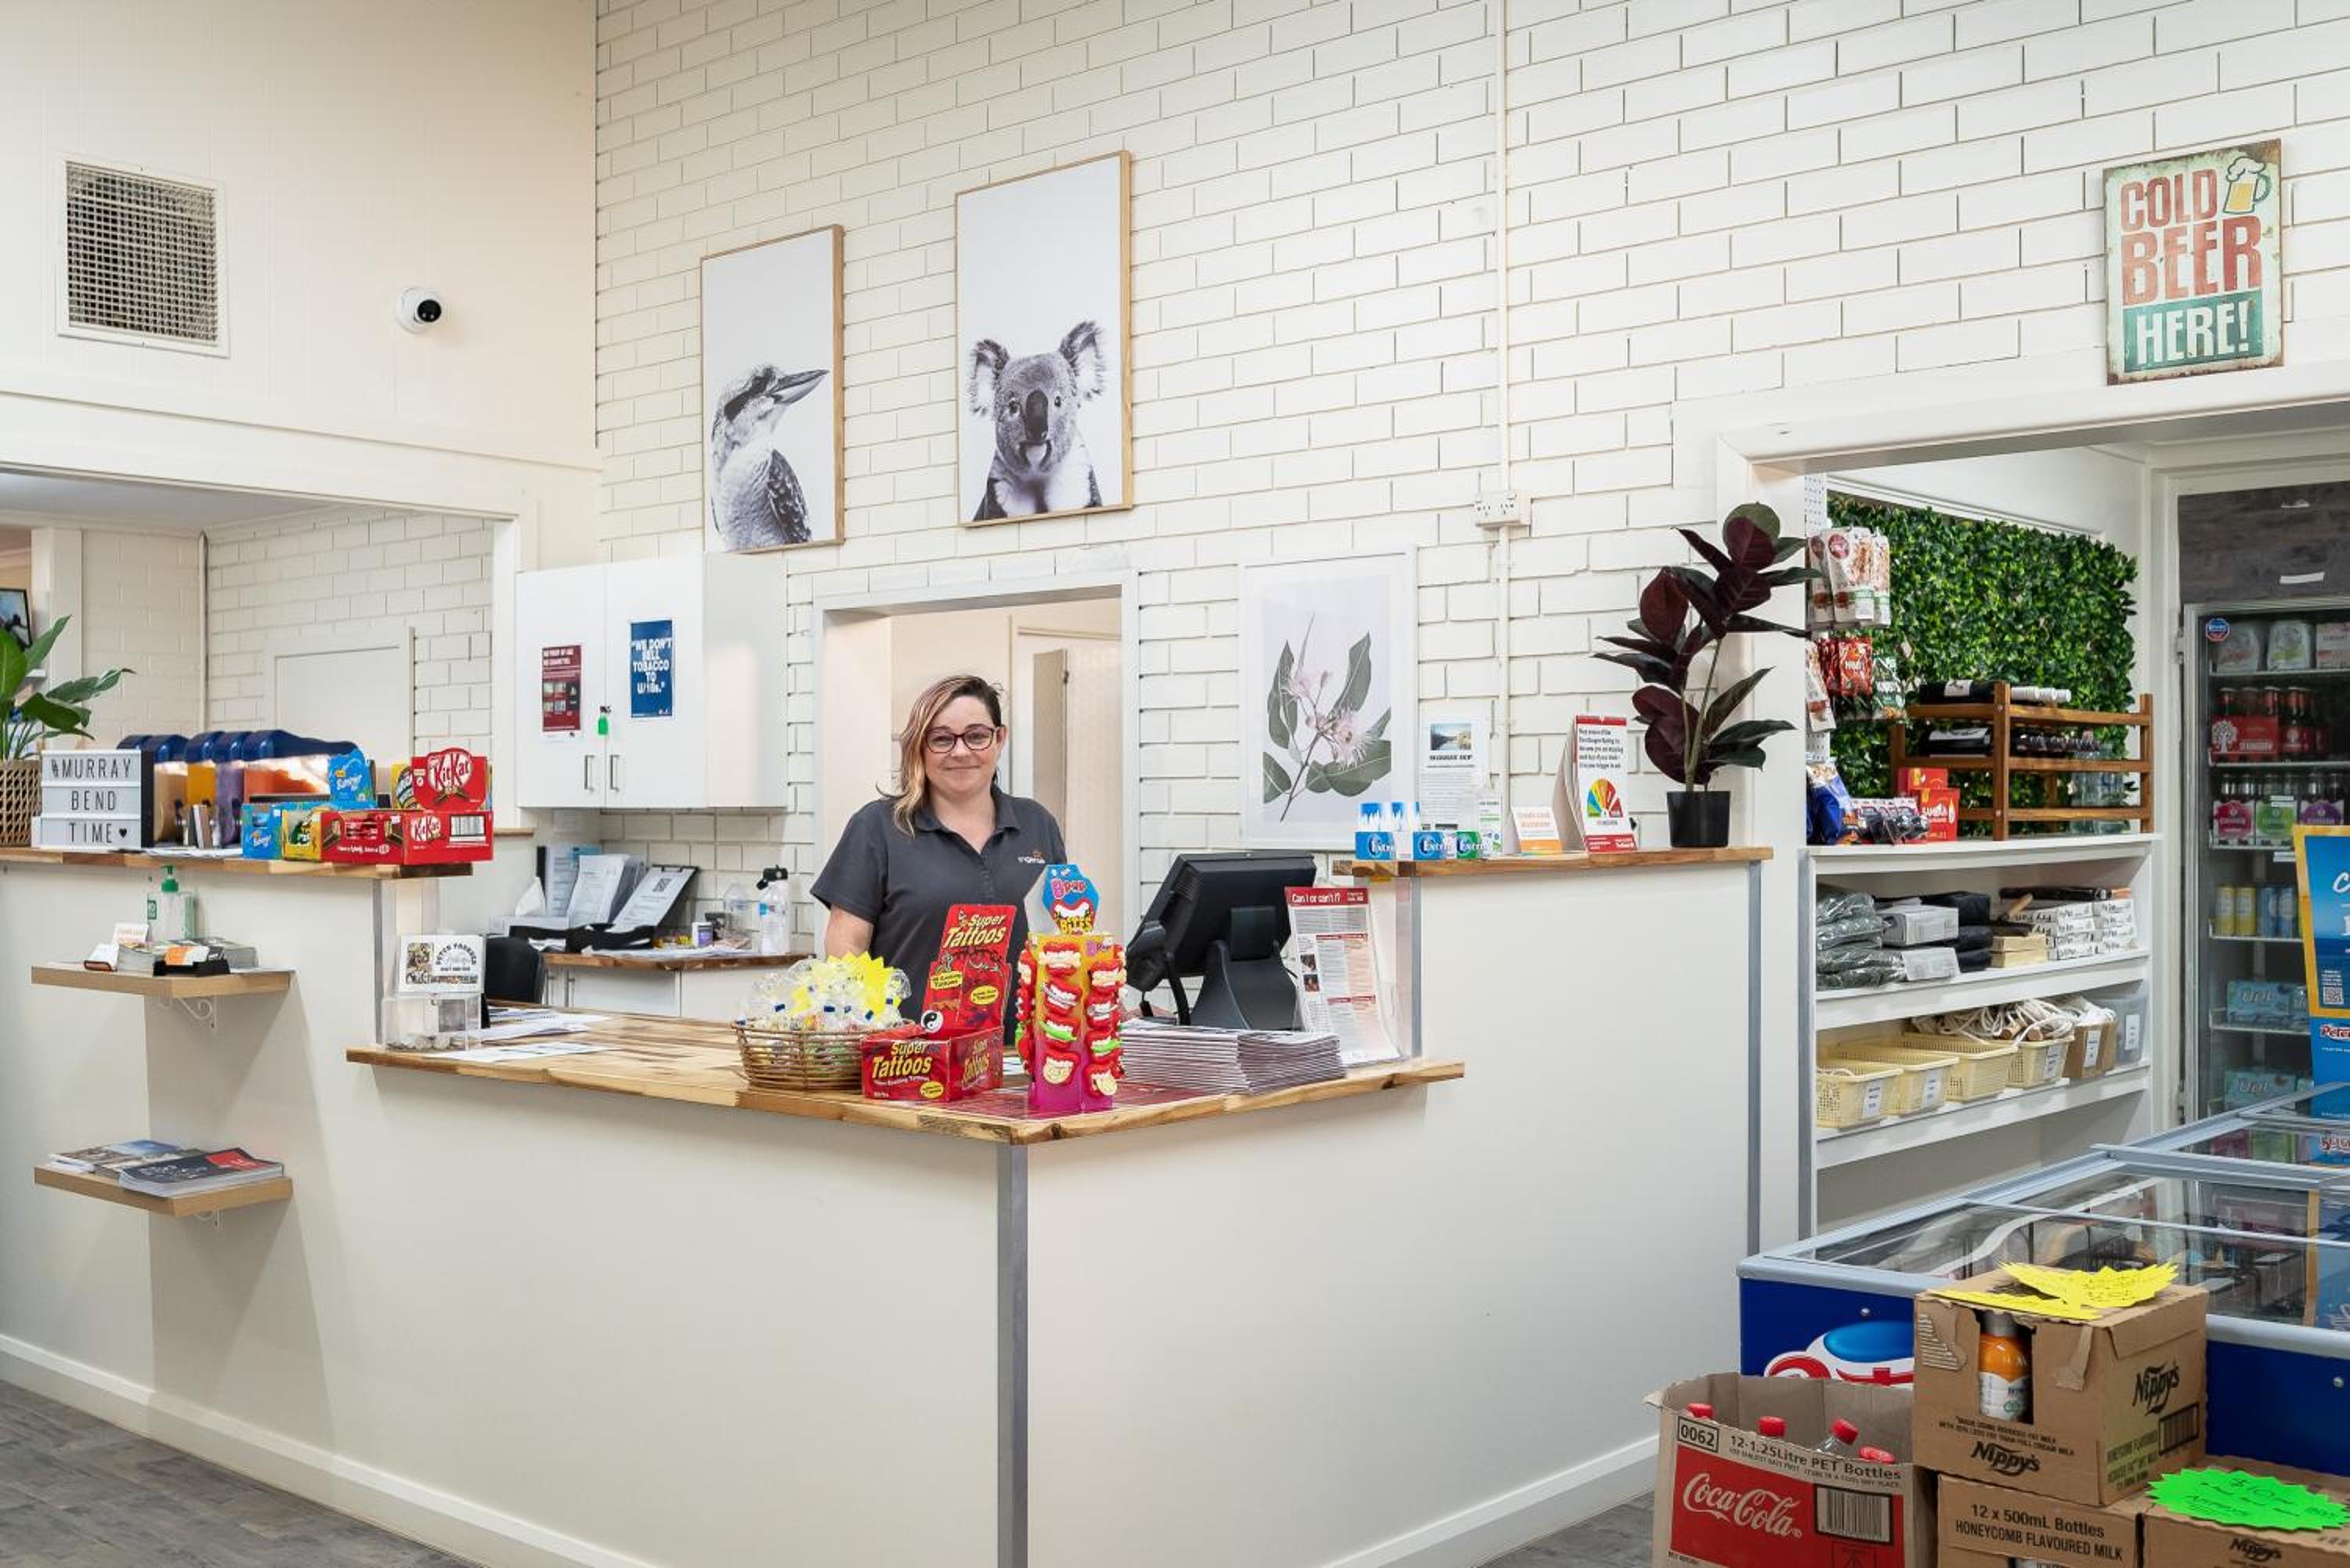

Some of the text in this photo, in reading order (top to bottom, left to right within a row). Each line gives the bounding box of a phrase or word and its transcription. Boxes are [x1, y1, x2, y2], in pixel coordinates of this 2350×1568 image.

[2120, 168, 2218, 231] COLD
[2120, 215, 2262, 306] BEER
[2136, 300, 2250, 365] HERE!
[430, 752, 470, 791] KitKat
[71, 790, 117, 811] BEND
[69, 822, 113, 844] TIME
[943, 927, 1007, 948] Tattoos
[968, 915, 1007, 929] Super
[891, 1041, 928, 1057] Super
[872, 1056, 932, 1078] Tattoos
[2131, 1360, 2181, 1416] Nippy's
[1680, 1424, 1716, 1447] 0062
[1812, 1454, 1839, 1473] PET
[1844, 1461, 1902, 1481] Bottles
[1970, 1440, 2041, 1476] Nippy's
[1683, 1472, 1800, 1537] Coca-Cola
[1971, 1504, 2106, 1538] 12 x 500mL Bottles
[1955, 1519, 2123, 1561] HONEYCOMB FLAVOURED MILK
